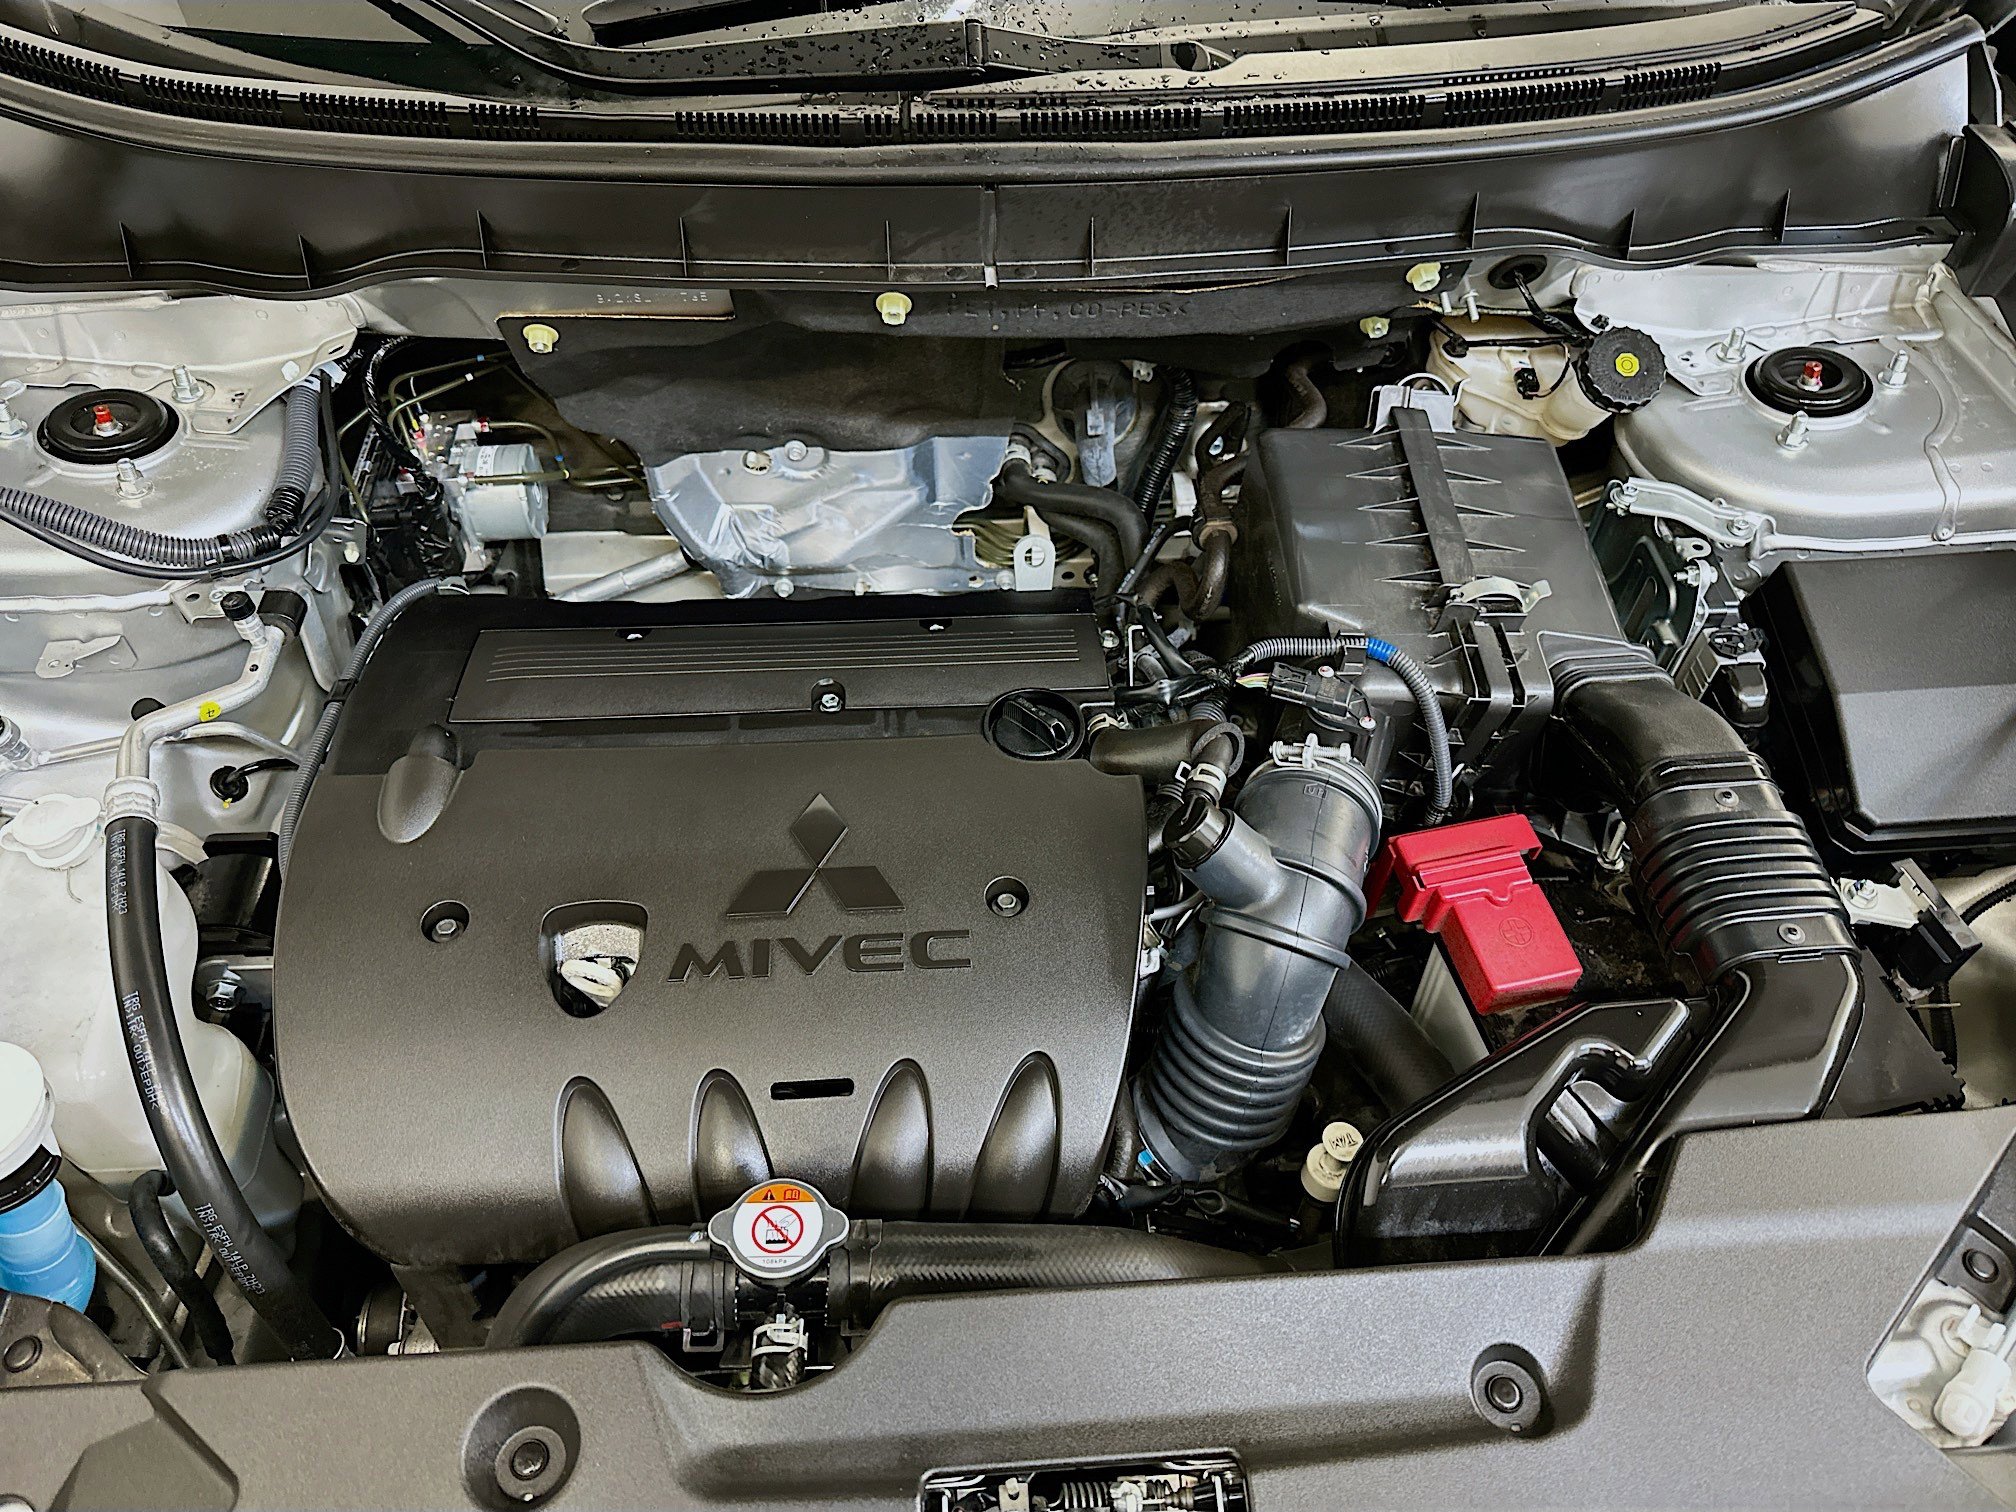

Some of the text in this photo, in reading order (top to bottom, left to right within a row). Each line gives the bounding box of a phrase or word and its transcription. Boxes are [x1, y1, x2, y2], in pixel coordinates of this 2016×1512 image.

[667, 929, 973, 982] MIVEC
[214, 1224, 233, 1248] ESFH
[230, 1250, 249, 1271] 14LP
